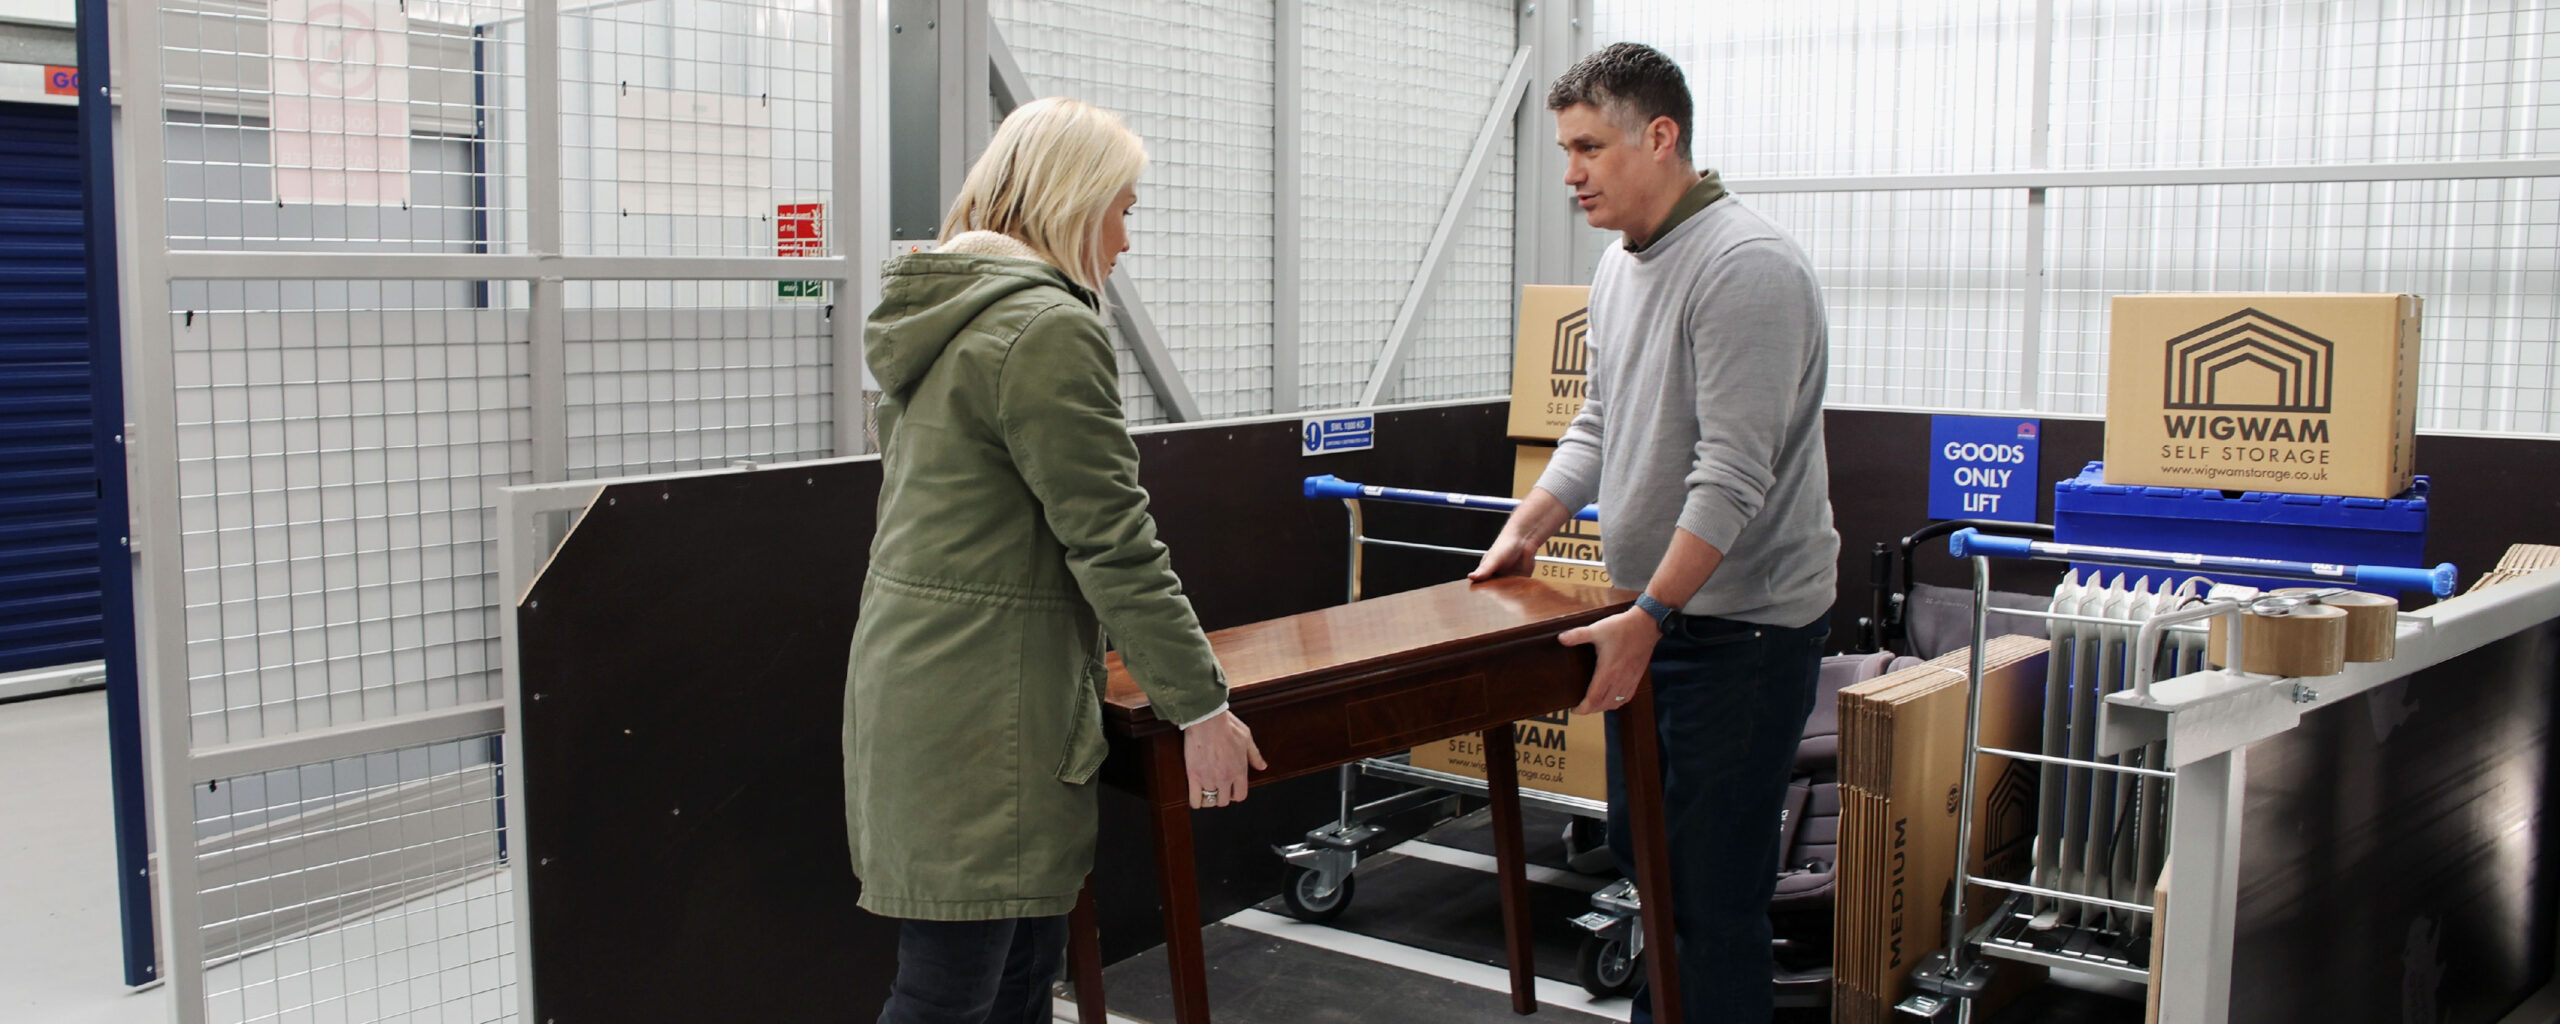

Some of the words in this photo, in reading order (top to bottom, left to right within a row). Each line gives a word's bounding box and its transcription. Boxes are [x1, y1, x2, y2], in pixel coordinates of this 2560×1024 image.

[1546, 402, 1580, 415] SELF
[2163, 414, 2330, 444] WIGWAM
[1943, 441, 2025, 464] GOODS
[2161, 445, 2210, 460] SELF
[2222, 446, 2330, 465] STORAGE
[1953, 466, 2013, 488] ONLY
[2161, 464, 2328, 482] www.wigwamstorage.co.uk
[1963, 492, 2002, 513] LIFT
[1542, 565, 1575, 578] SELF
[1449, 739, 1483, 755] SELF
[1889, 817, 1907, 970] MEDIUM
